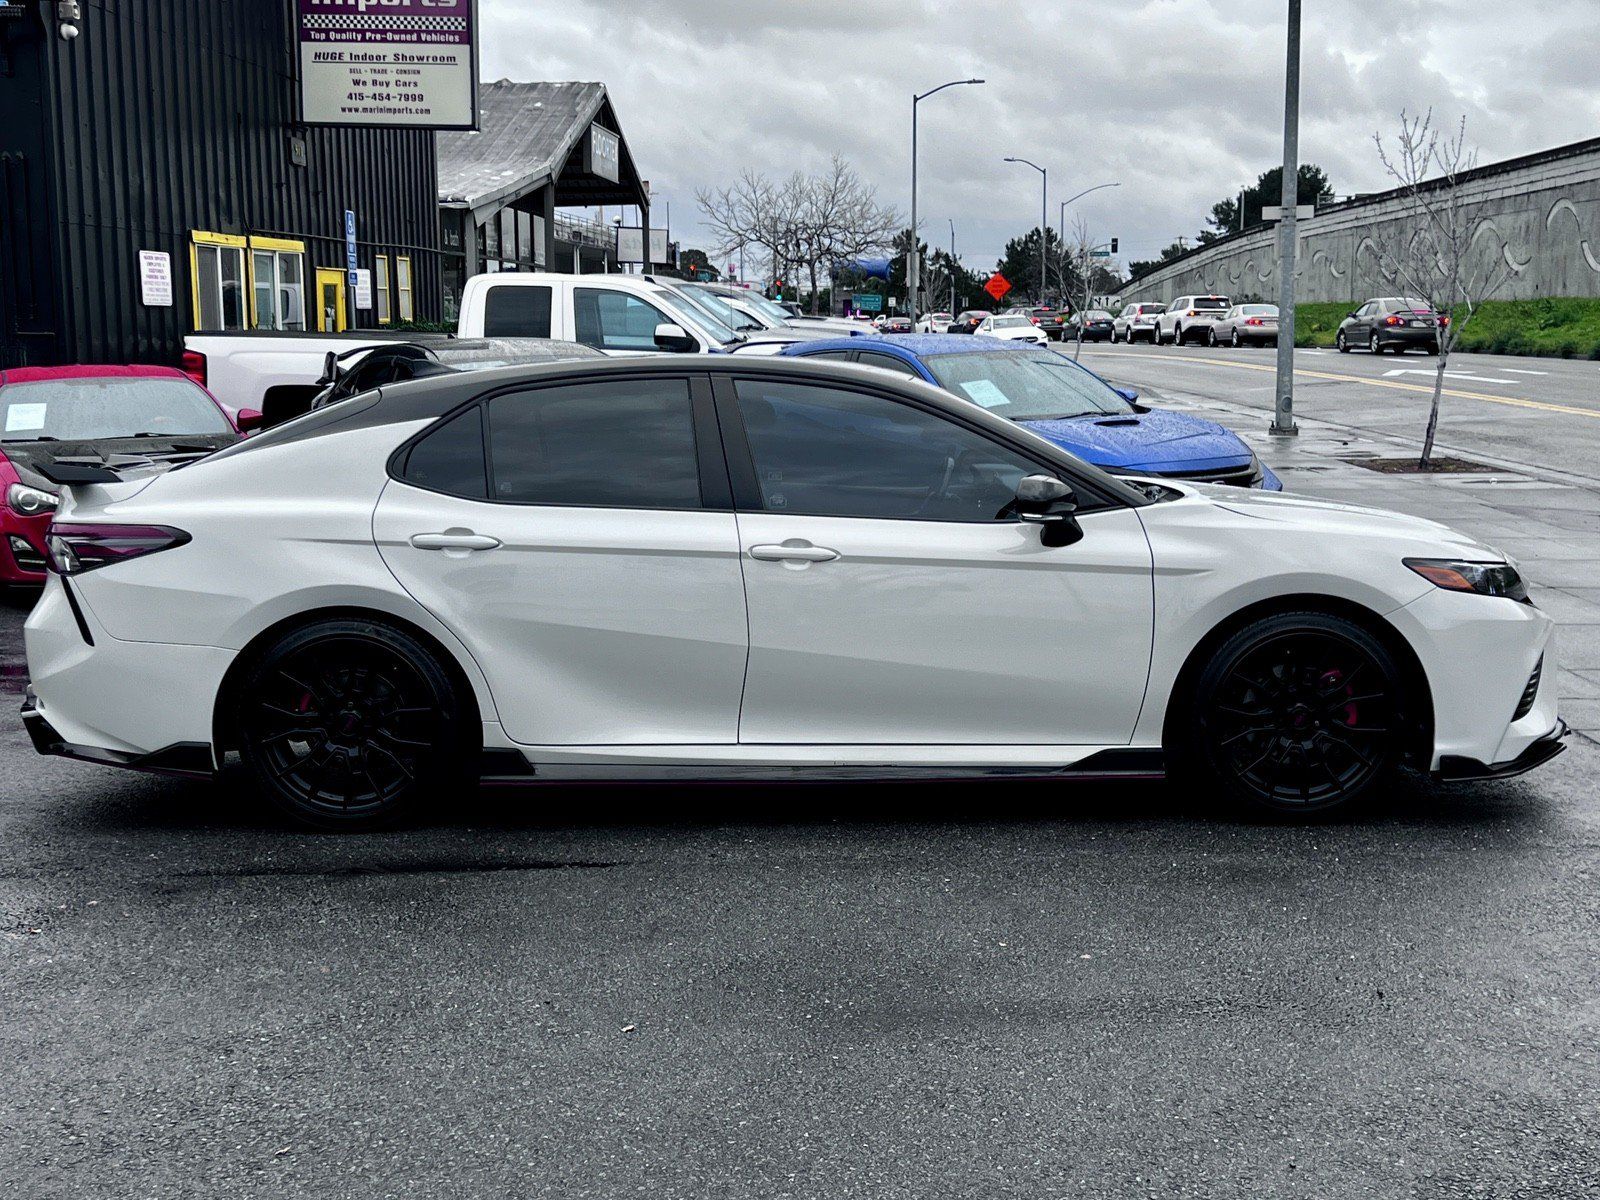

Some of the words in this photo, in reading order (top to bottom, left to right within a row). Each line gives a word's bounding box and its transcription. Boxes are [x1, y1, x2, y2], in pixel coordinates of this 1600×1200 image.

[310, 31, 326, 40] Top
[329, 31, 362, 41] Quality
[365, 32, 417, 42] Pre-Owned
[420, 33, 460, 42] Vehicles
[313, 51, 345, 61] HUGE
[349, 52, 388, 62] Indoor
[393, 53, 457, 63] Showroom
[351, 78, 368, 87] We
[371, 79, 390, 88] Buy
[395, 79, 418, 88] Cars
[346, 92, 424, 103] 415-454-7999
[340, 105, 431, 116] www.marinimports.com
